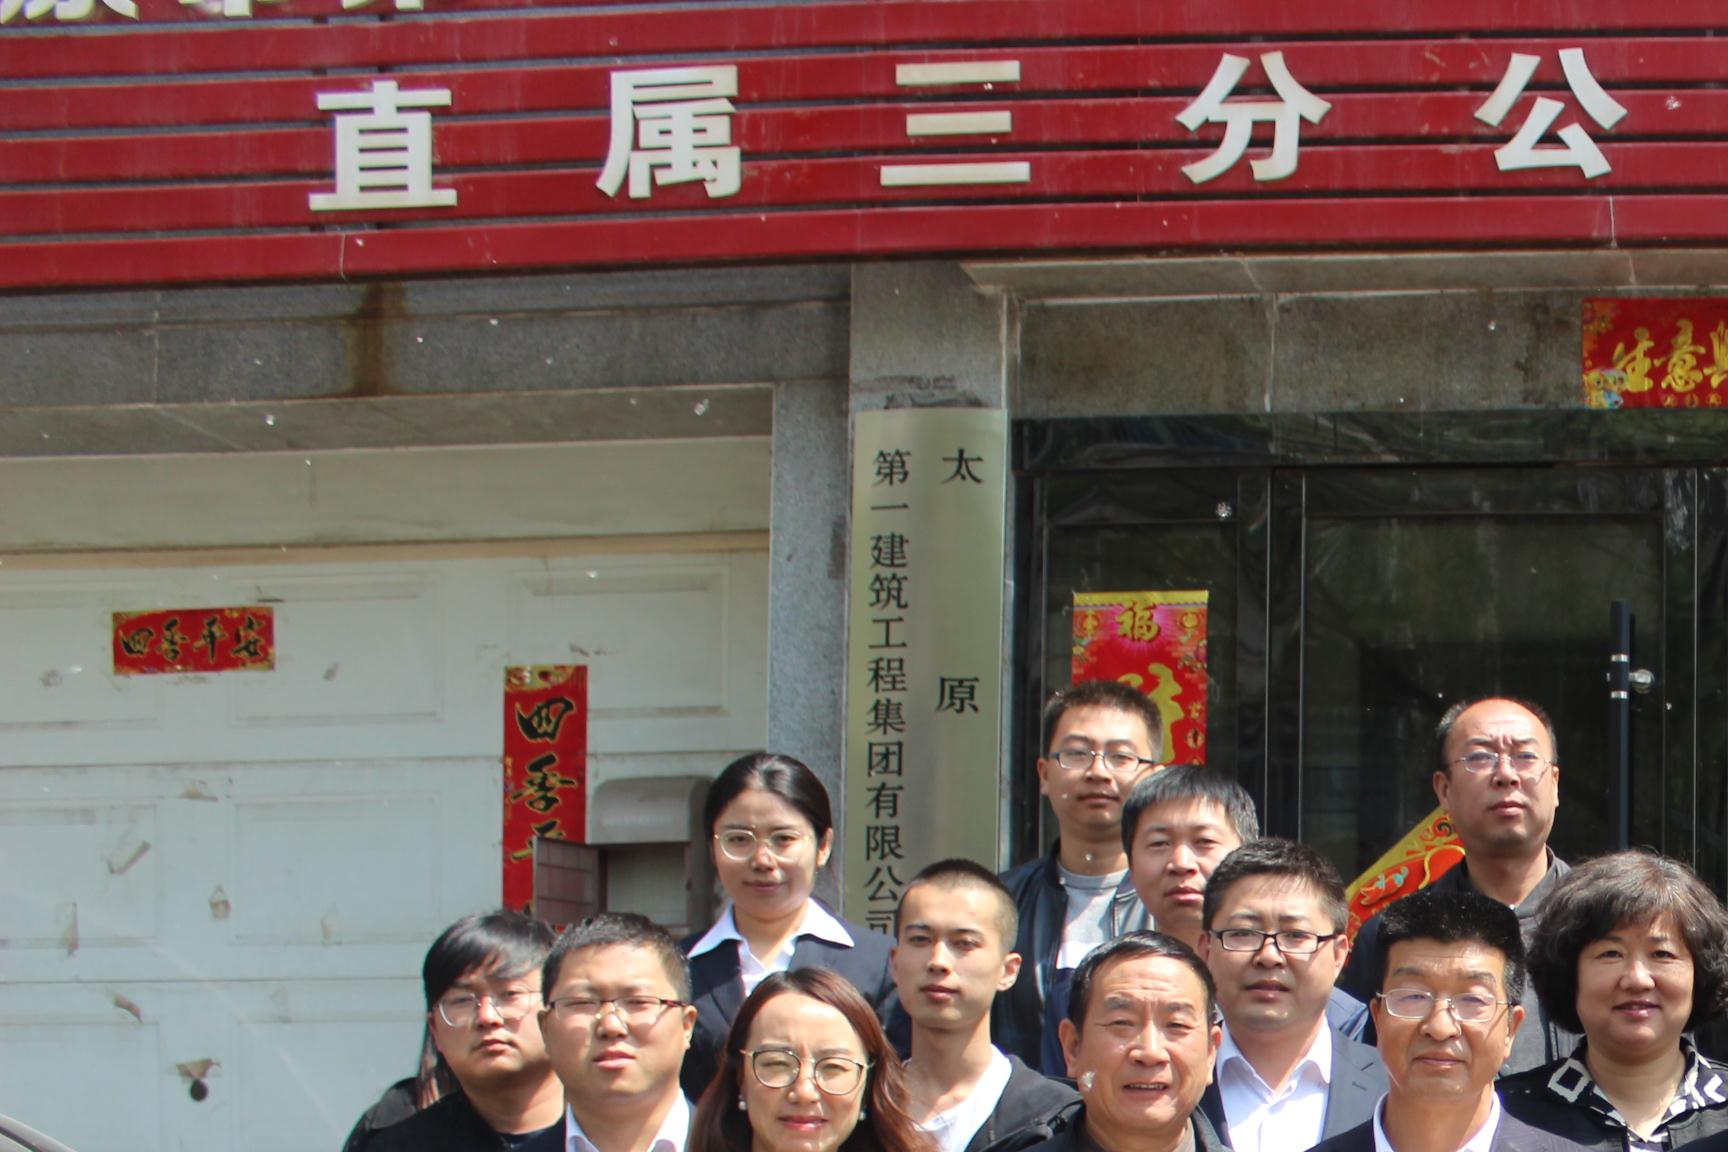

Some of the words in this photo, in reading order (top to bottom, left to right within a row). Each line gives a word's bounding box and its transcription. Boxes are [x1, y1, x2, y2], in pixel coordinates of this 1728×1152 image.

[863, 449, 910, 938] 第一建筑工程集团有限公司
[1116, 600, 1160, 641] 福
